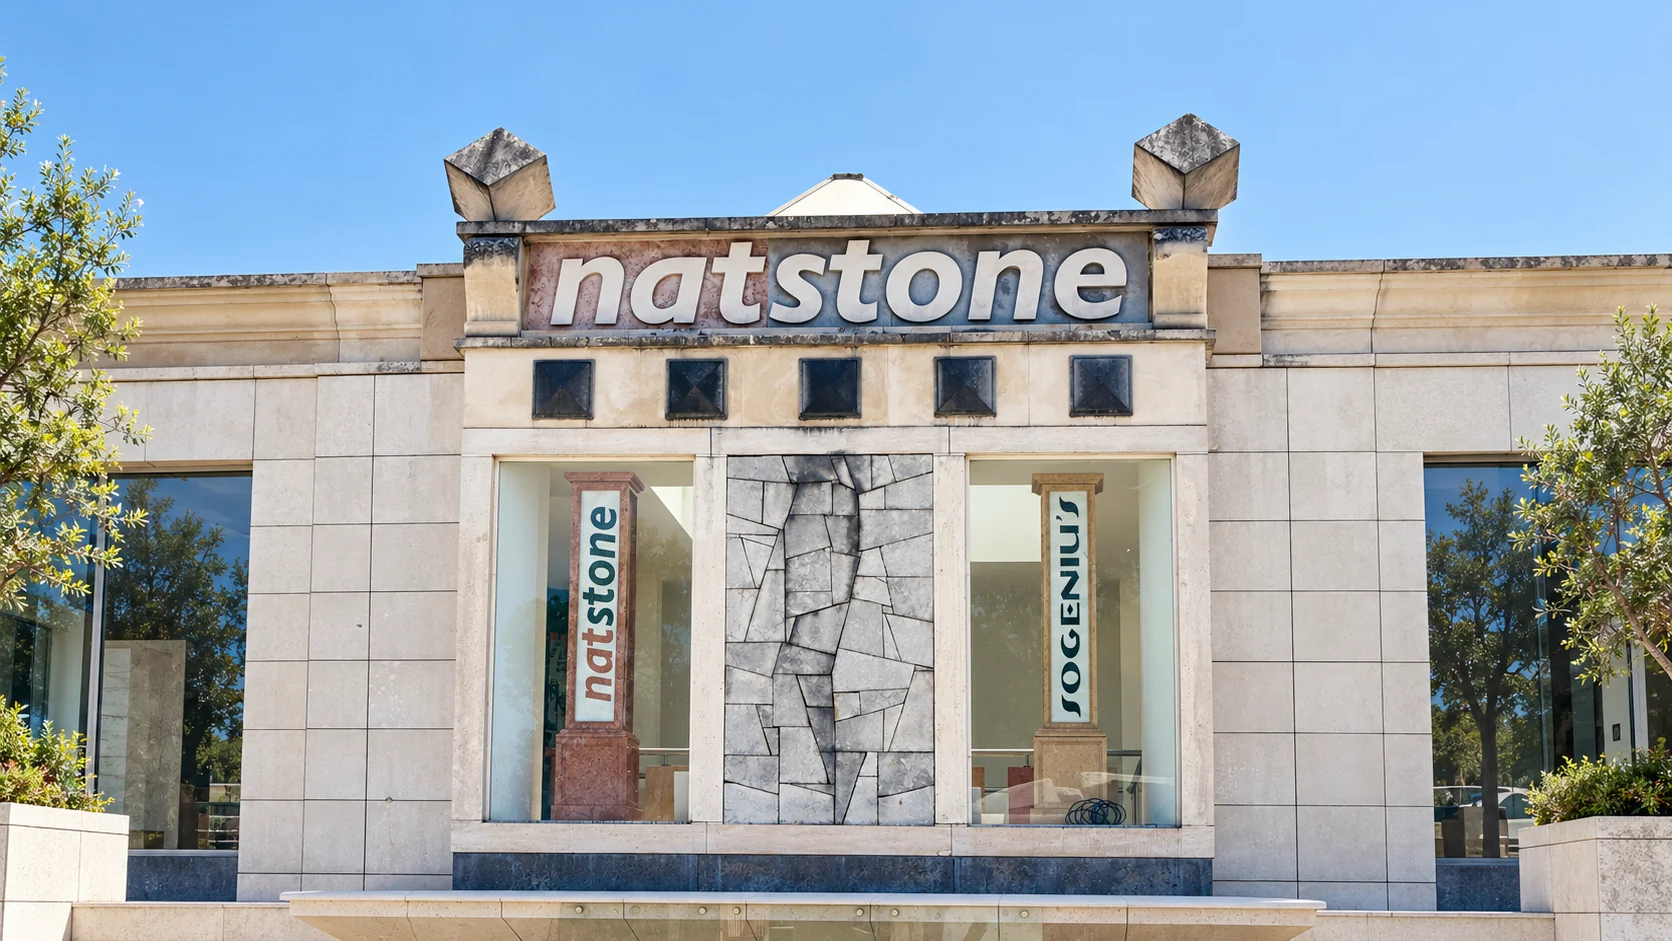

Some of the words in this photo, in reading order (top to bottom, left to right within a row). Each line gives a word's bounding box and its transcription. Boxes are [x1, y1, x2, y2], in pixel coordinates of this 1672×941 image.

[550, 239, 1128, 326] natstone
[578, 505, 617, 703] natstone
[1055, 495, 1082, 719] SOGENIU'S
